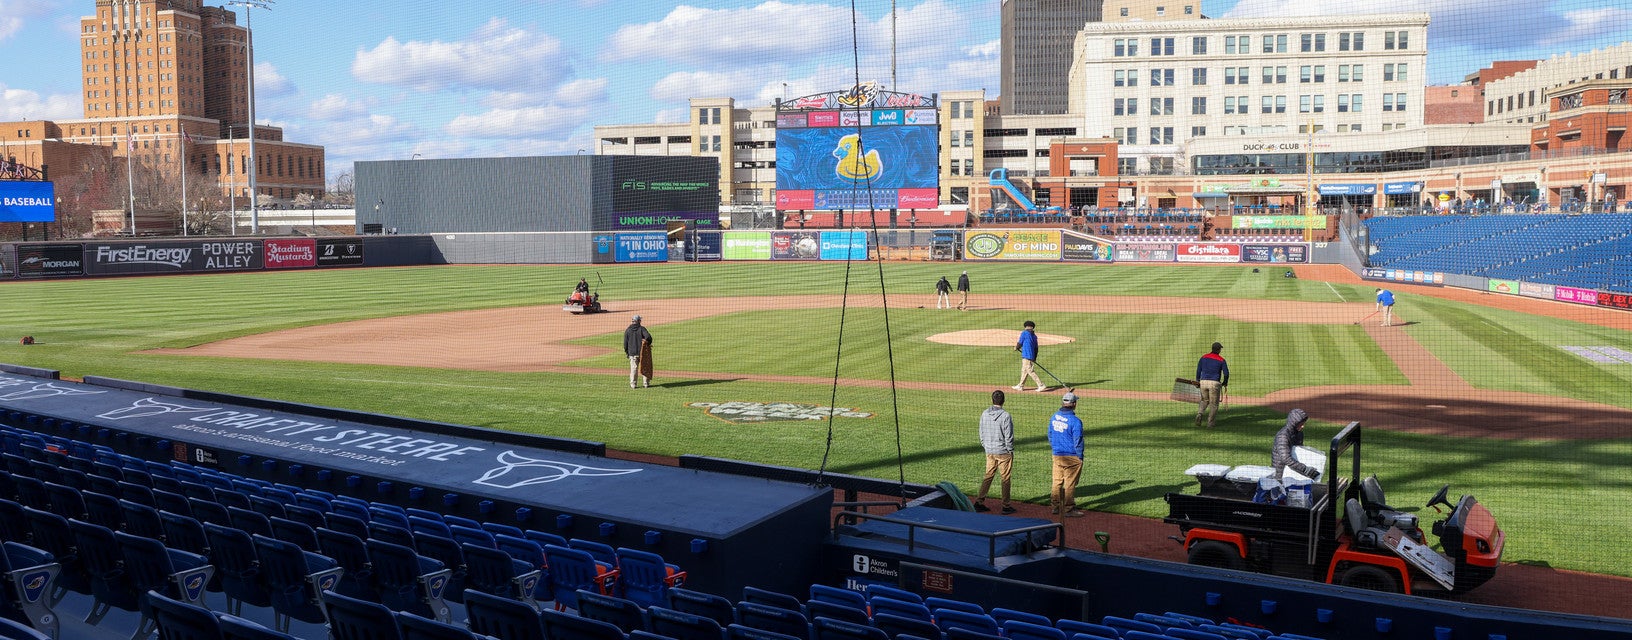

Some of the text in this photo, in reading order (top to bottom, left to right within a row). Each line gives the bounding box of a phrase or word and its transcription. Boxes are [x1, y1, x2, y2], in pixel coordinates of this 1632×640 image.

[622, 182, 646, 190] FIS
[4, 197, 52, 206] BASEBALL
[1013, 233, 1048, 243] PEACE
[202, 242, 254, 256] POWER
[267, 243, 312, 254] Stadium
[643, 240, 665, 250] OHIO
[1013, 243, 1058, 251] OF MIND
[97, 246, 192, 263] FirstEnergy
[267, 252, 313, 263] Mustard
[205, 256, 251, 269] ALLEY
[190, 411, 487, 461] CRAFTY STEERE
[299, 443, 341, 454] food
[332, 451, 406, 467] market
[870, 559, 888, 568] Akron
[870, 566, 898, 577] Children's
[846, 579, 868, 592] Her
